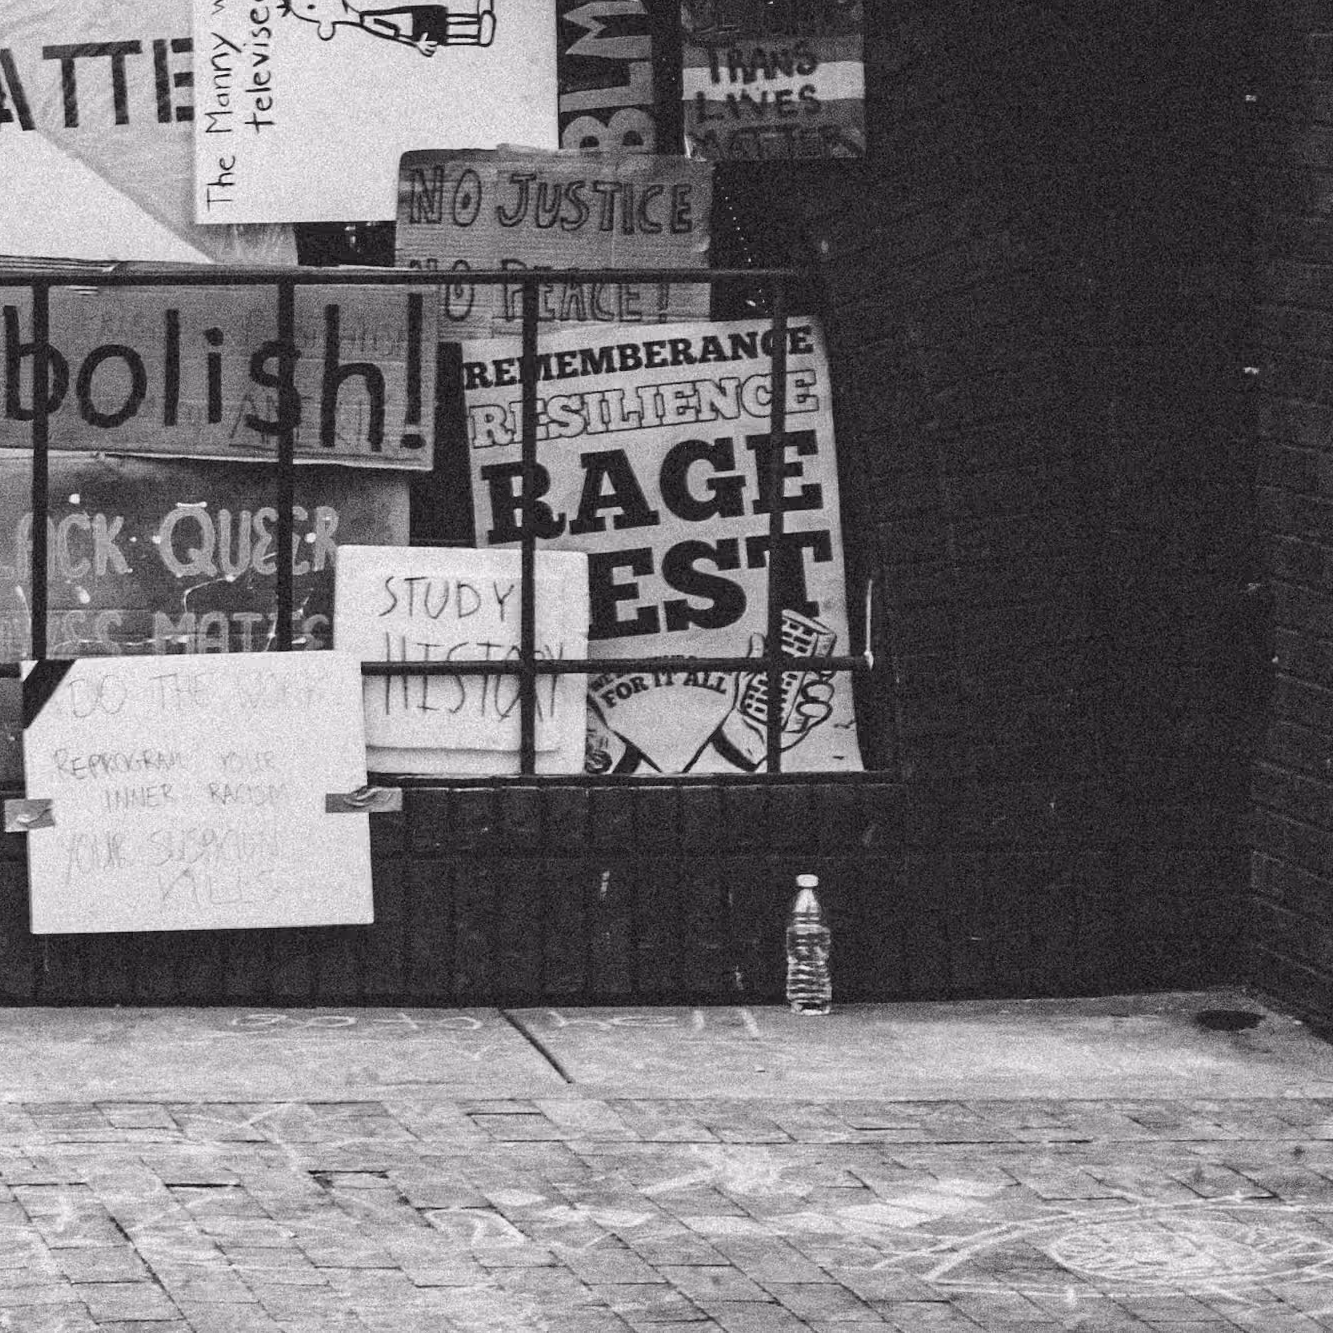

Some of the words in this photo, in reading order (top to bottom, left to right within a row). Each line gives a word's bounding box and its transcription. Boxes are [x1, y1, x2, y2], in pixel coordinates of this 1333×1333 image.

[205, 32, 243, 134] Manny
[706, 41, 819, 86] TRANS
[695, 84, 823, 123] LIVES
[207, 155, 236, 211] The
[408, 168, 483, 228] NO
[496, 171, 695, 235] JUSTICE
[463, 326, 814, 391] REMEMBERANCE
[469, 369, 819, 450] RESILIENCE
[480, 429, 824, 545] RAGE
[155, 504, 340, 579] QUEER
[379, 575, 515, 623] STUDY
